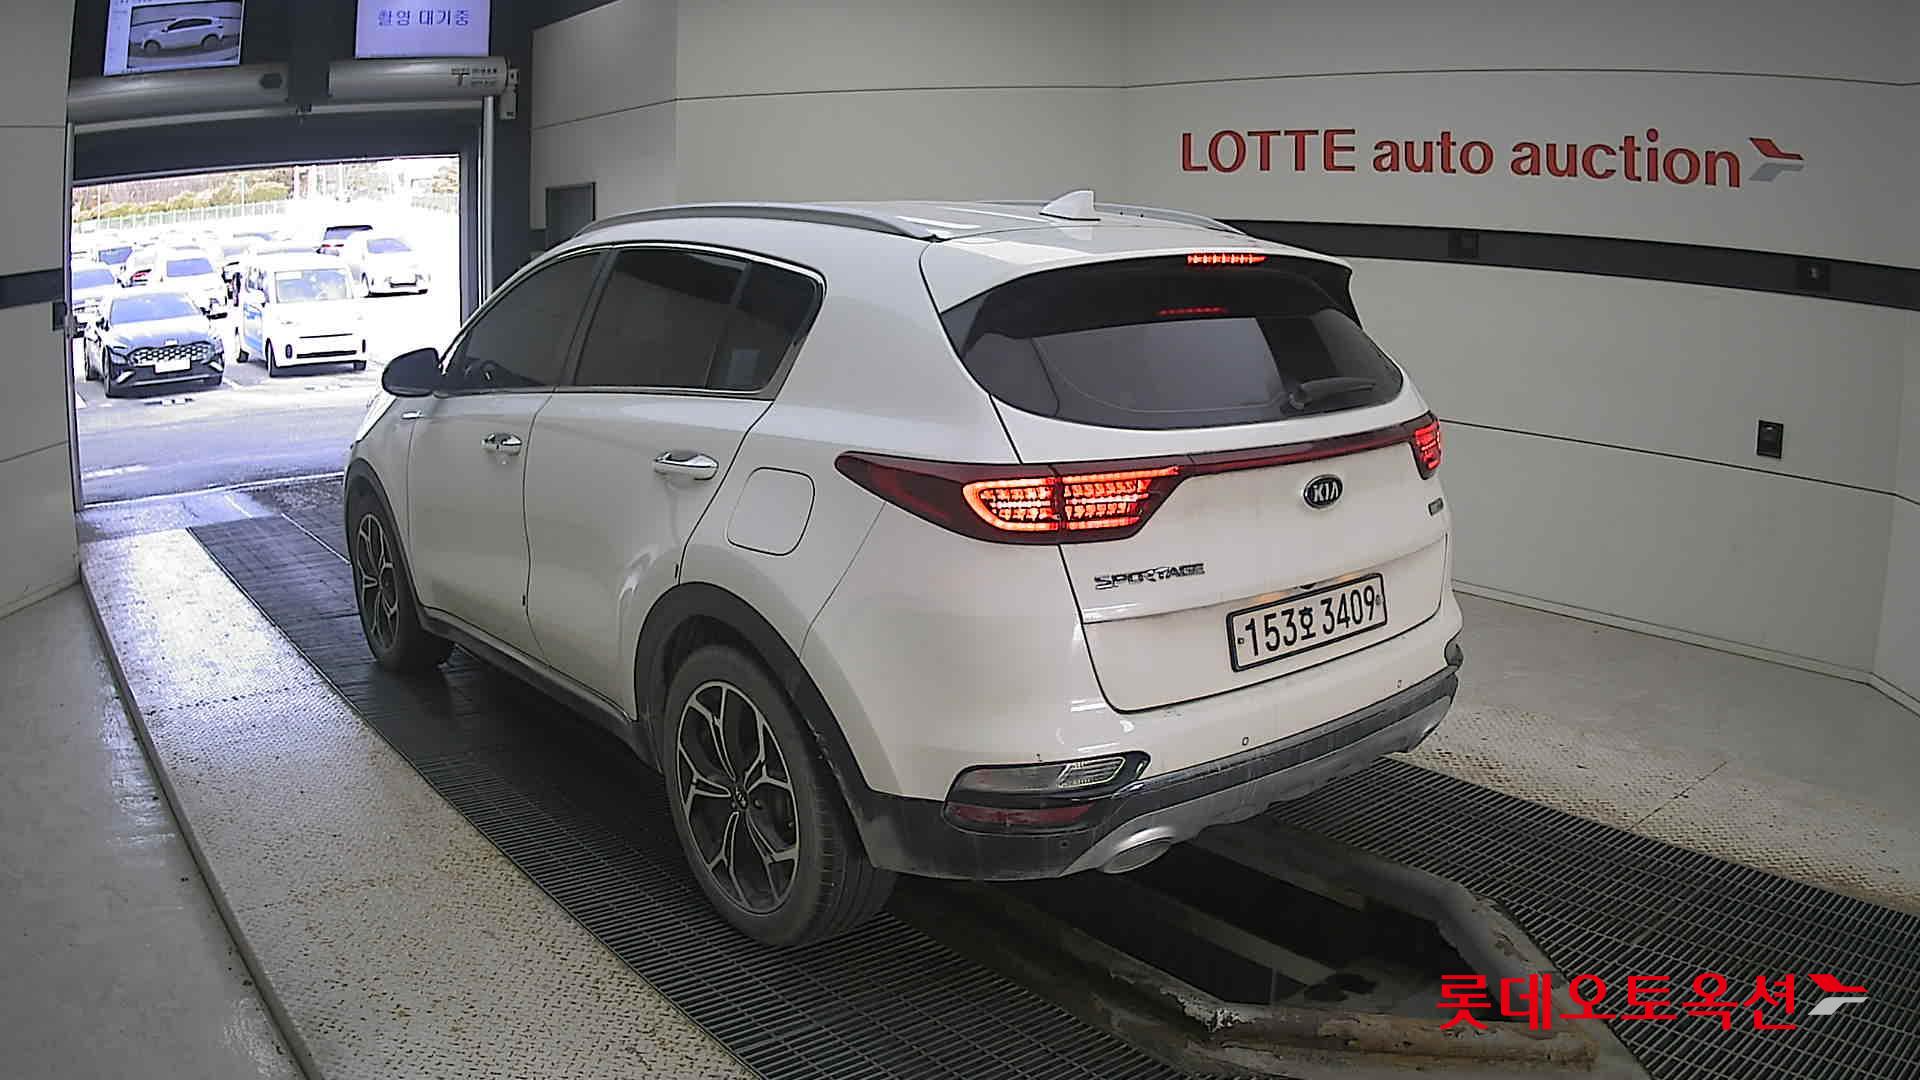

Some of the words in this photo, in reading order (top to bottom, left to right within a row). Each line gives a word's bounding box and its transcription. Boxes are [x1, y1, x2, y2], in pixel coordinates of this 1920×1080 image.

[419, 9, 469, 26] 대기중
[1181, 128, 1356, 173] LOTTE
[1373, 131, 1494, 174] auto
[1510, 128, 1741, 188] auction
[1310, 479, 1340, 504] KIA
[1093, 562, 1206, 591] SPORTAGE
[1245, 606, 1316, 657] 153호
[1320, 585, 1375, 635] 3409
